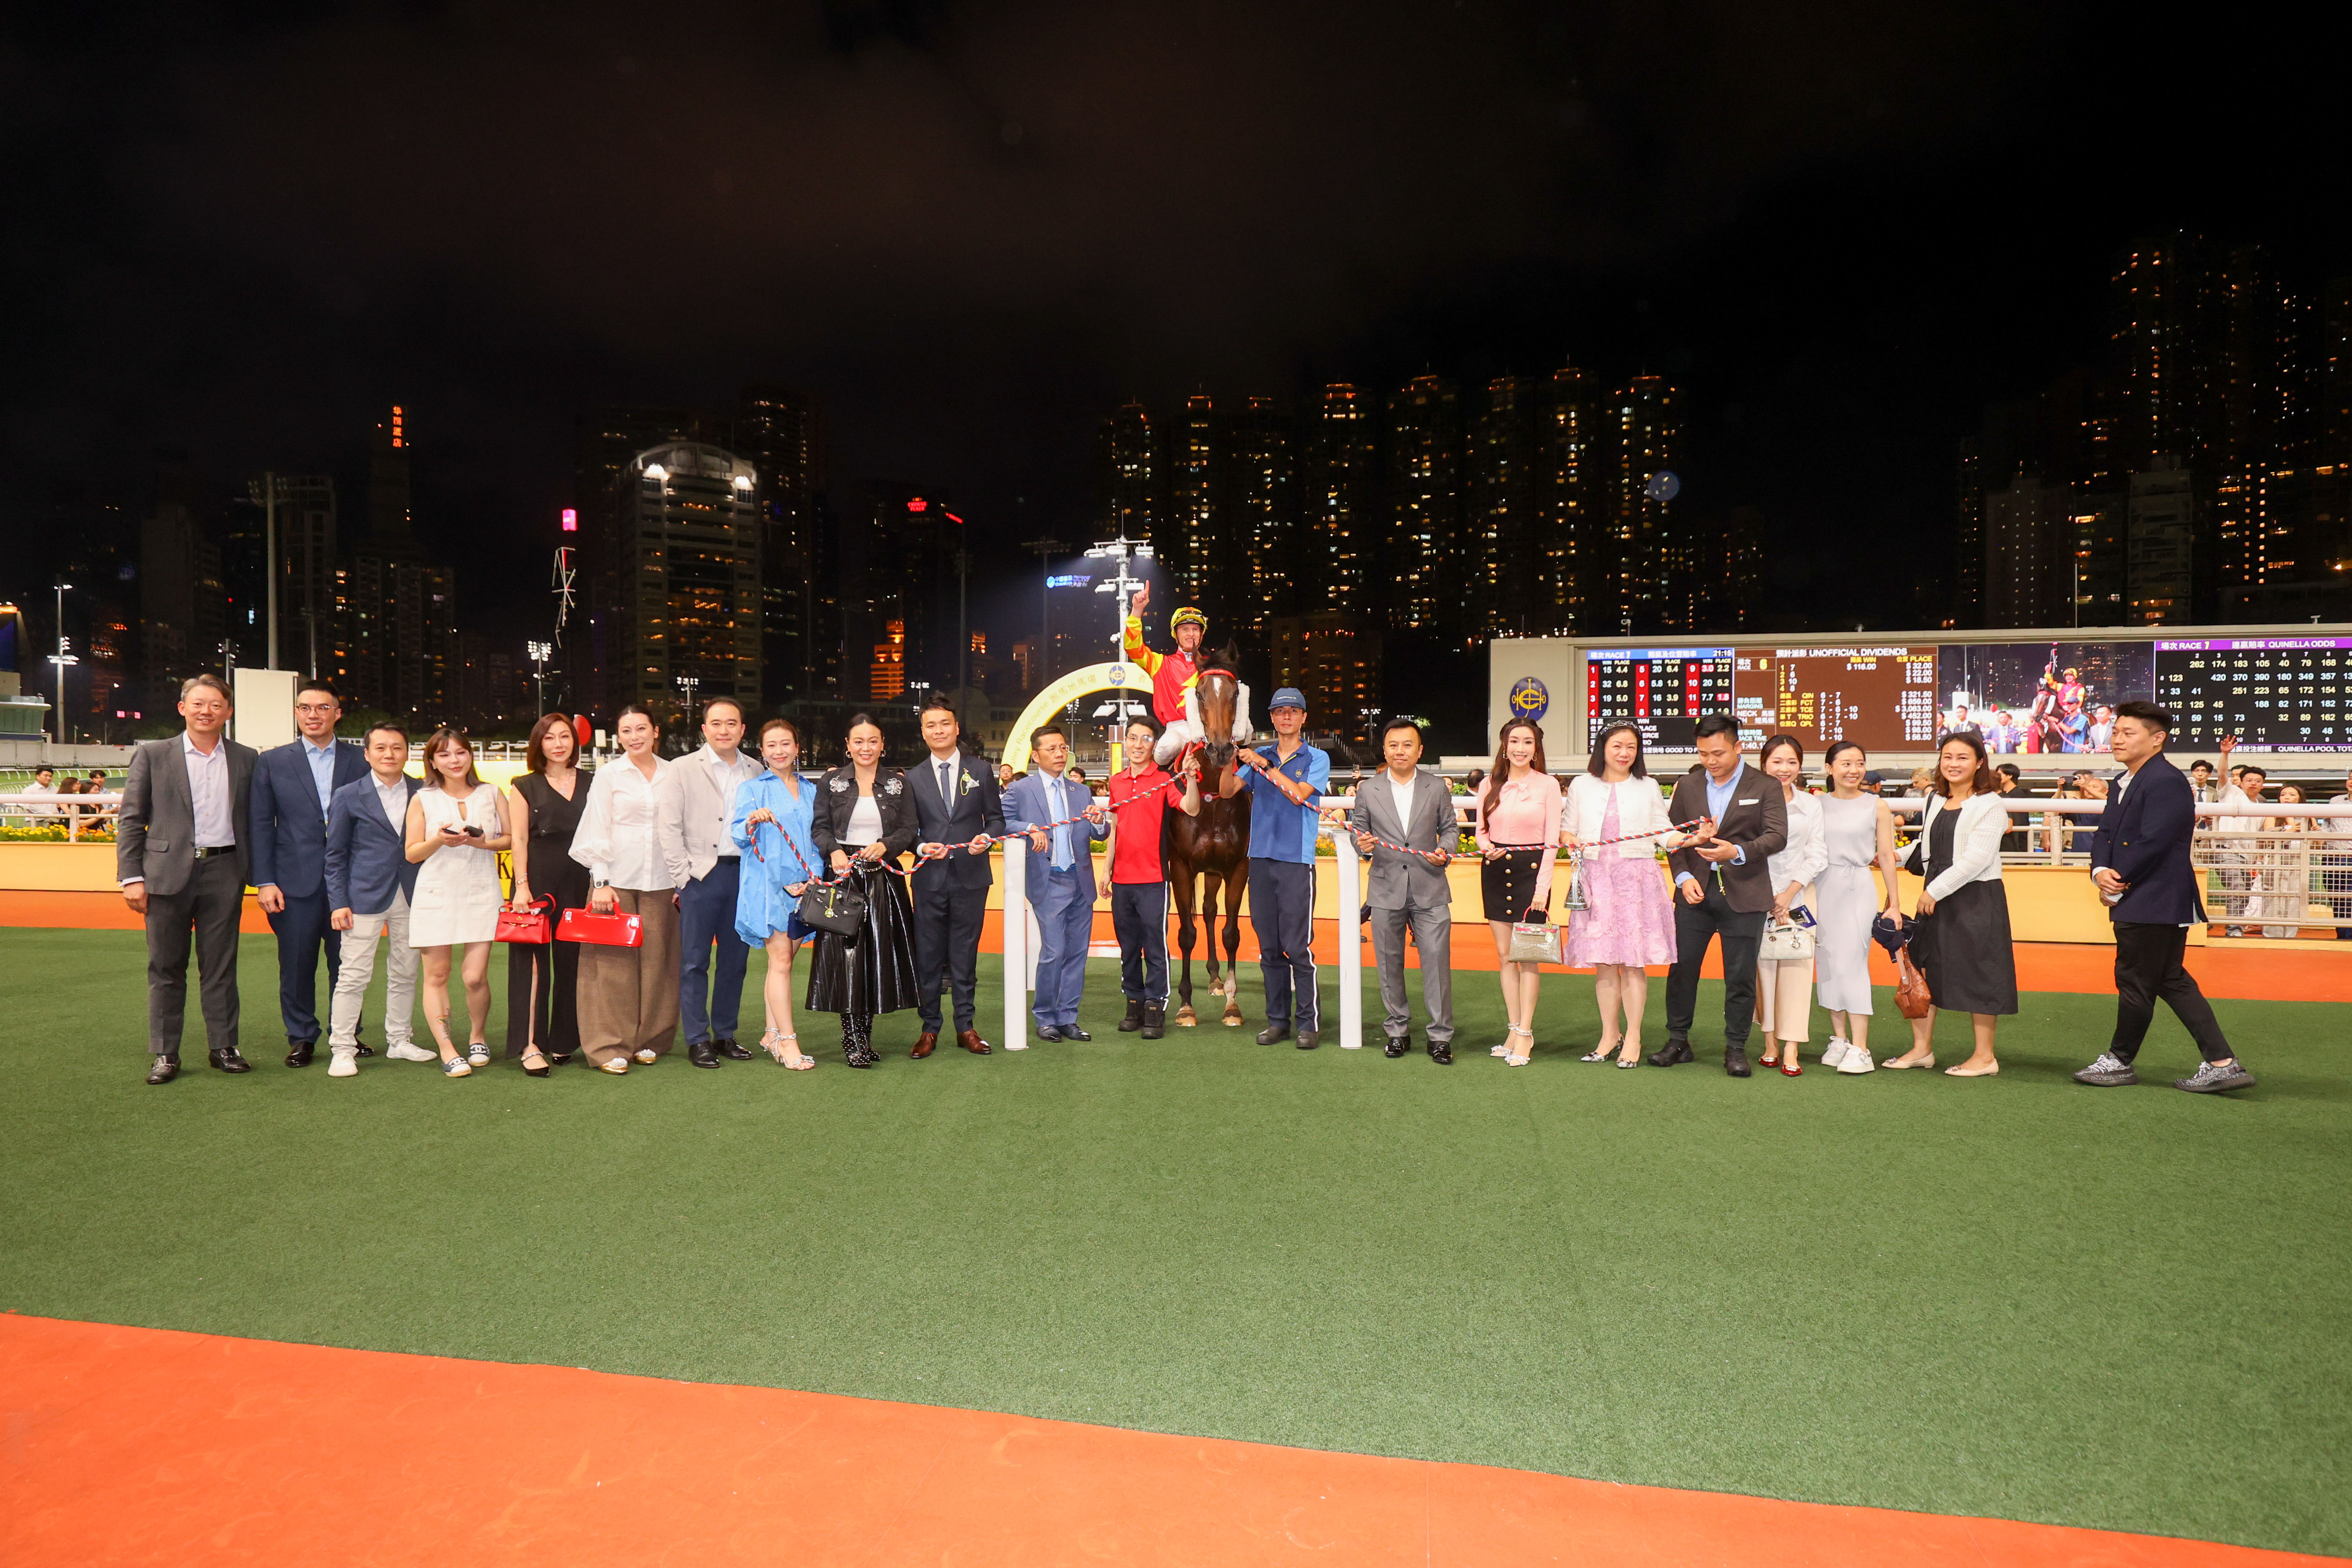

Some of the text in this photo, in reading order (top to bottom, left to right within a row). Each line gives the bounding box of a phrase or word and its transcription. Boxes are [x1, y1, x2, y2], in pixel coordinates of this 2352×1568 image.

[2161, 642, 2177, 650] 場次
[1712, 649, 1733, 657] 21:15
[1809, 649, 1859, 657] UNOFFICIAL
[1860, 647, 1908, 656] DIVIDENDS
[1760, 658, 1768, 671] 6
[1049, 674, 1097, 703] 跑馬地馬場
[1010, 701, 1049, 769] alley Racecourse
